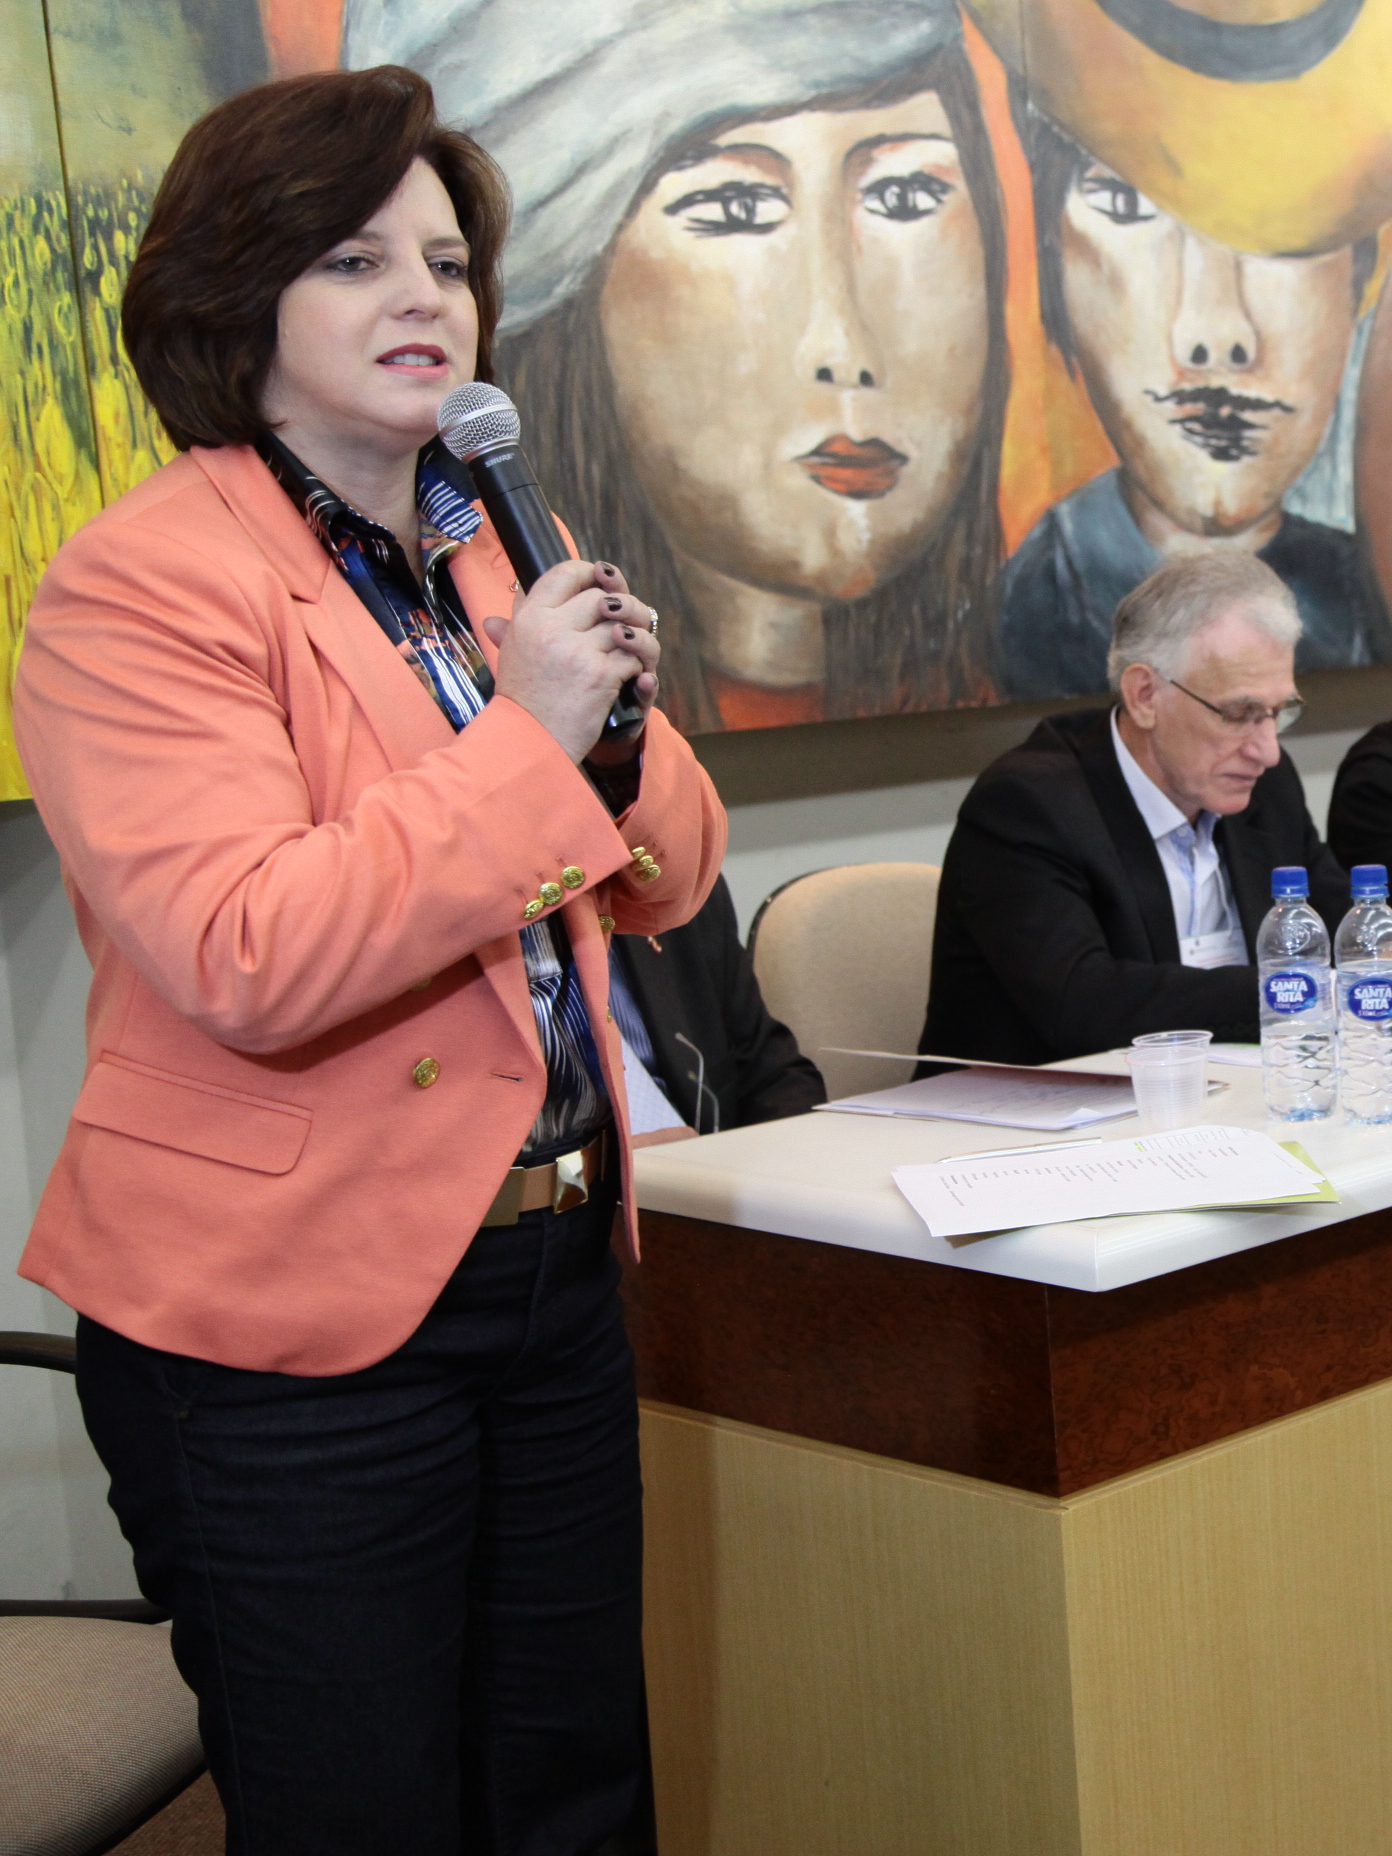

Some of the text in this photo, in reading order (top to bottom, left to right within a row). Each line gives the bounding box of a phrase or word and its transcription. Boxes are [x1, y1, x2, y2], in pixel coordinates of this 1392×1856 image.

[485, 453, 513, 467] SHURE
[1270, 981, 1308, 992] SANTA
[1276, 991, 1304, 1003] RITA
[1354, 988, 1392, 999] SANTA
[1361, 998, 1390, 1010] RITA
